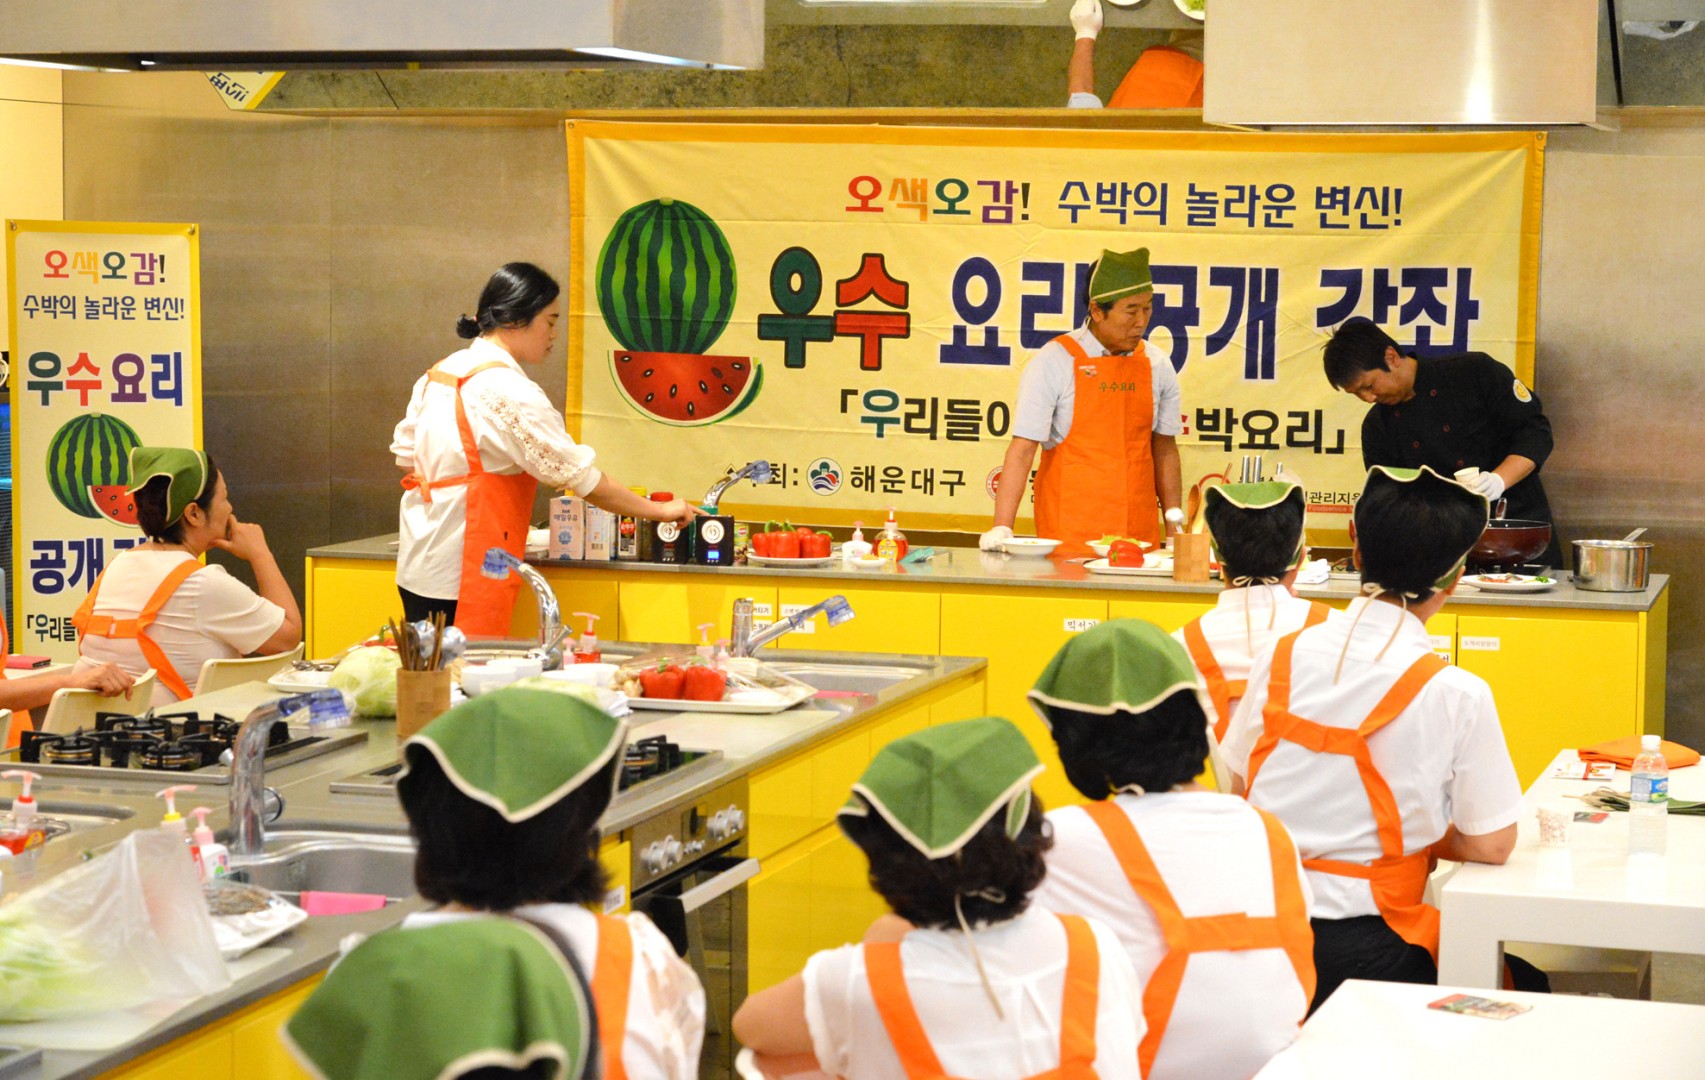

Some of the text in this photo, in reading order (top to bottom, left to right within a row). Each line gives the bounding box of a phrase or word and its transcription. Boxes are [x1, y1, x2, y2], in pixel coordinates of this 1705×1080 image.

[845, 175, 1403, 230] 오색오감! 수박의 놀라운 변신!
[43, 250, 165, 285] 오색오감!
[23, 295, 184, 321] 수박의 놀라운 변신!
[757, 246, 911, 371] 우수
[27, 351, 183, 407] 우수 요리
[1181, 407, 1345, 455] 박요리」
[744, 462, 798, 489] 최:
[850, 465, 966, 497] 해운대구
[1305, 490, 1361, 505] 관리지
[30, 538, 104, 595] 공개
[26, 613, 80, 643] 「우리들
